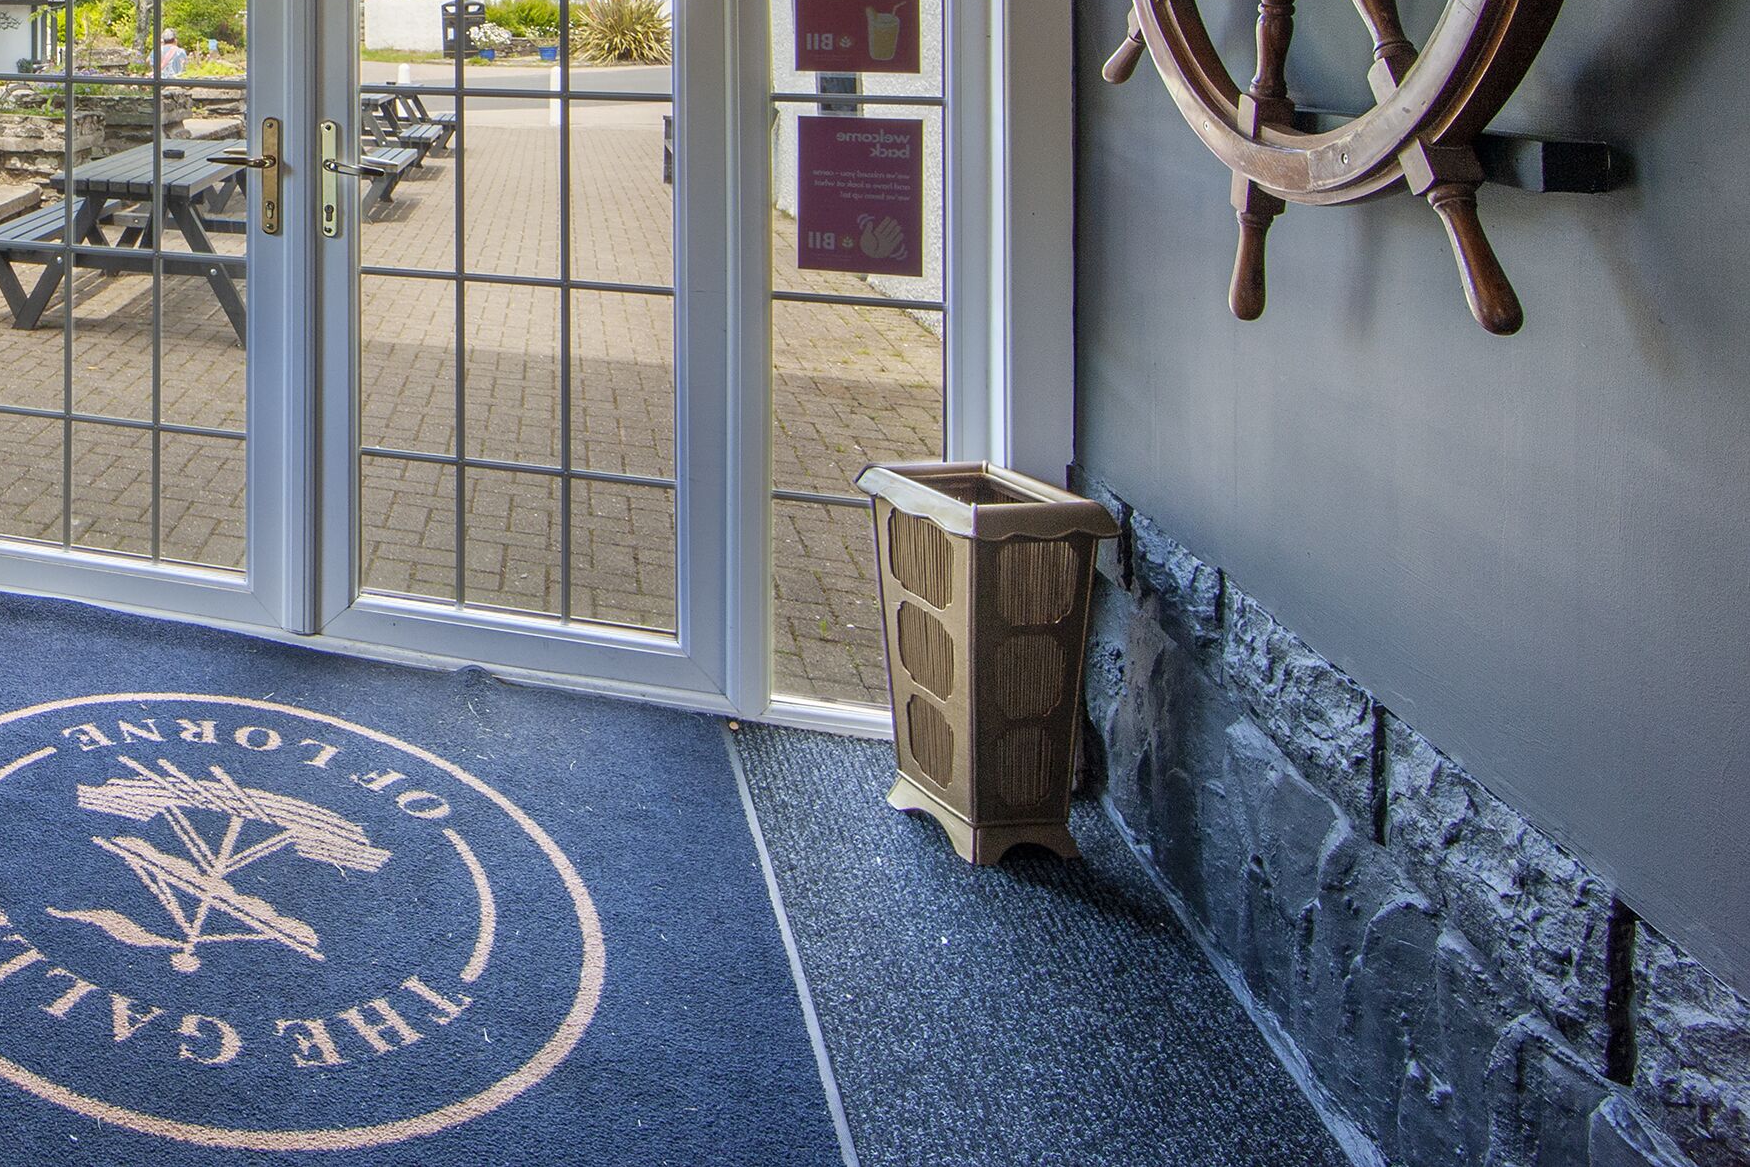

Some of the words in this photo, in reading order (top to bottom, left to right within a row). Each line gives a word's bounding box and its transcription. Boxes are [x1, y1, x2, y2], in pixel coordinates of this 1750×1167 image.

[61, 716, 340, 767] LORNE
[351, 767, 452, 821] OF
[274, 975, 473, 1068] THE
